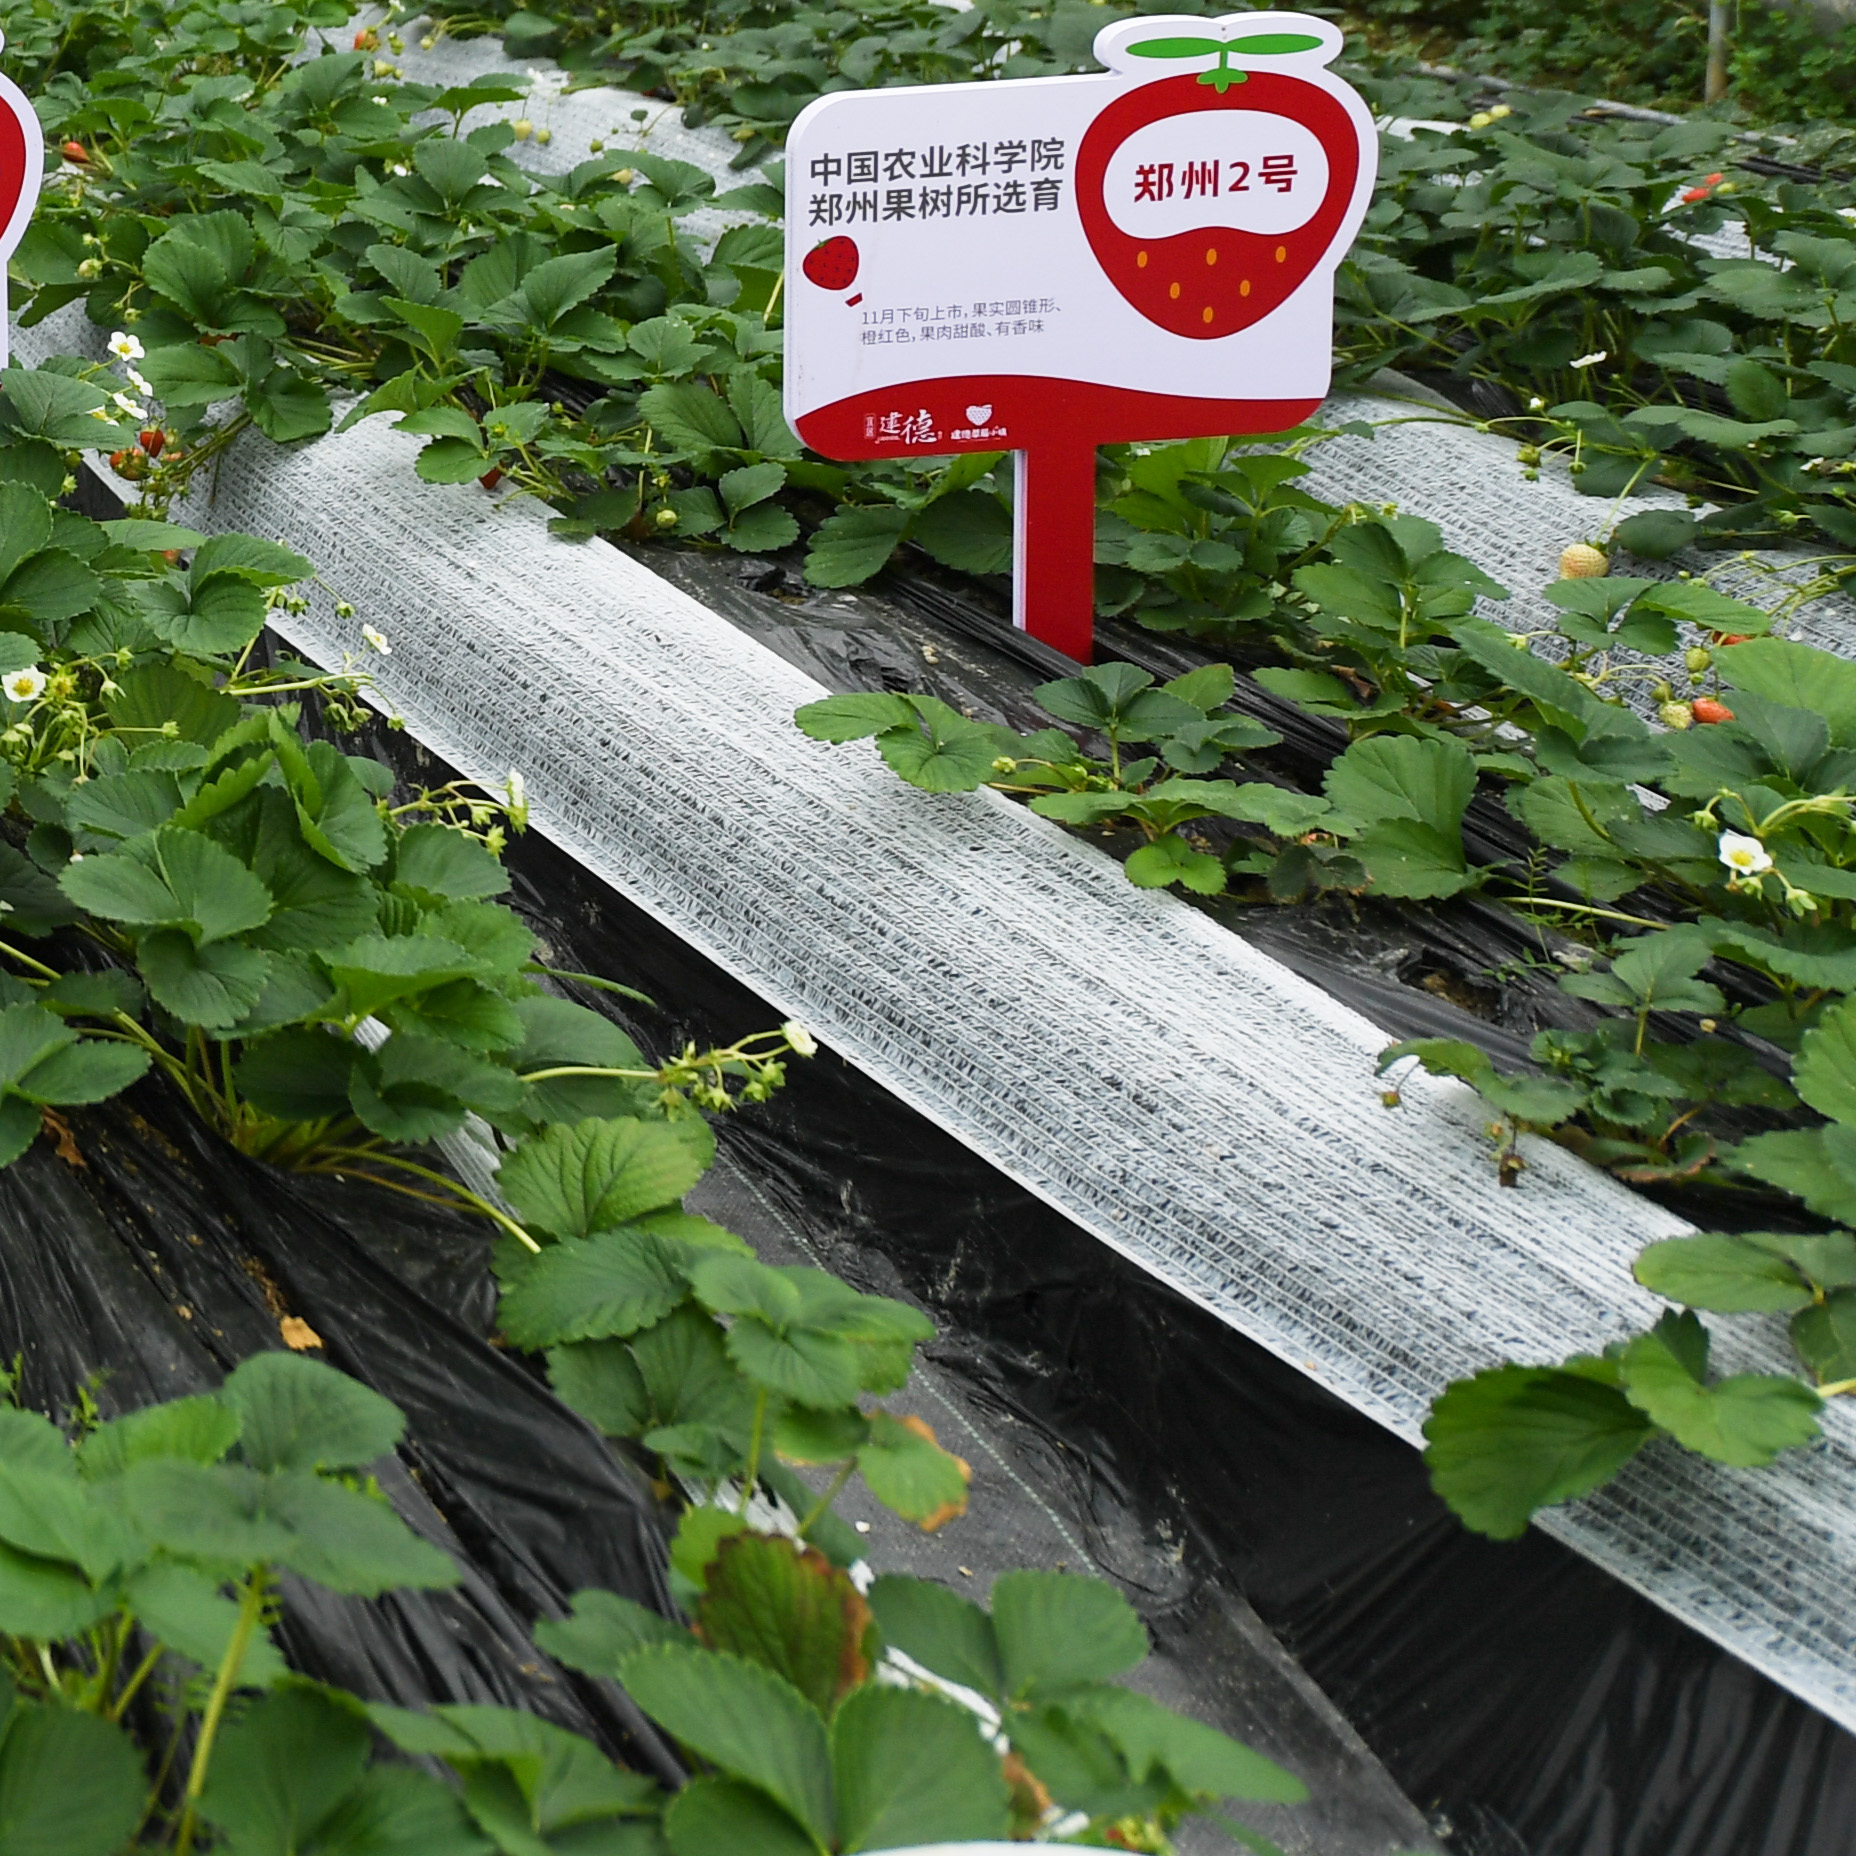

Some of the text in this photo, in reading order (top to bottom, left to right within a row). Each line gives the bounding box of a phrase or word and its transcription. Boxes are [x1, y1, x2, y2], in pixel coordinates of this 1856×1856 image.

[809, 136, 1065, 187] 中国农业科学院
[1133, 154, 1299, 203] 郑州2号
[808, 177, 1064, 227] 郑州果树所选育
